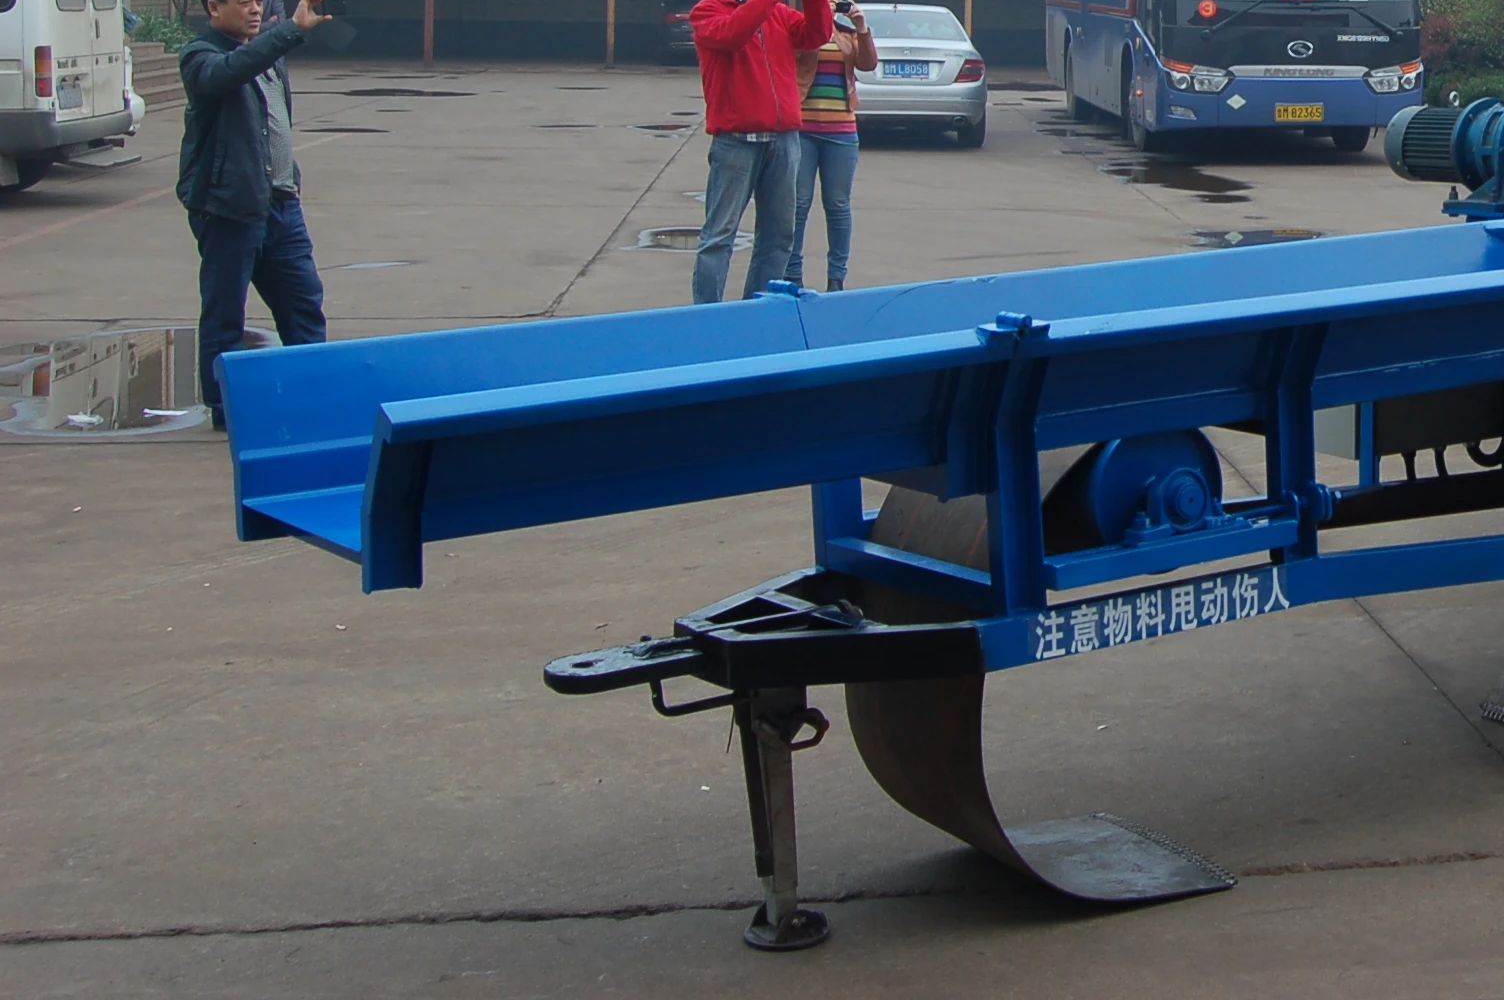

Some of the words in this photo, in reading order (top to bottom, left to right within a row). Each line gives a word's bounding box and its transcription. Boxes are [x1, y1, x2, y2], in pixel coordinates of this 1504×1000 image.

[1035, 566, 1291, 661] 注意物料甩动伤人
